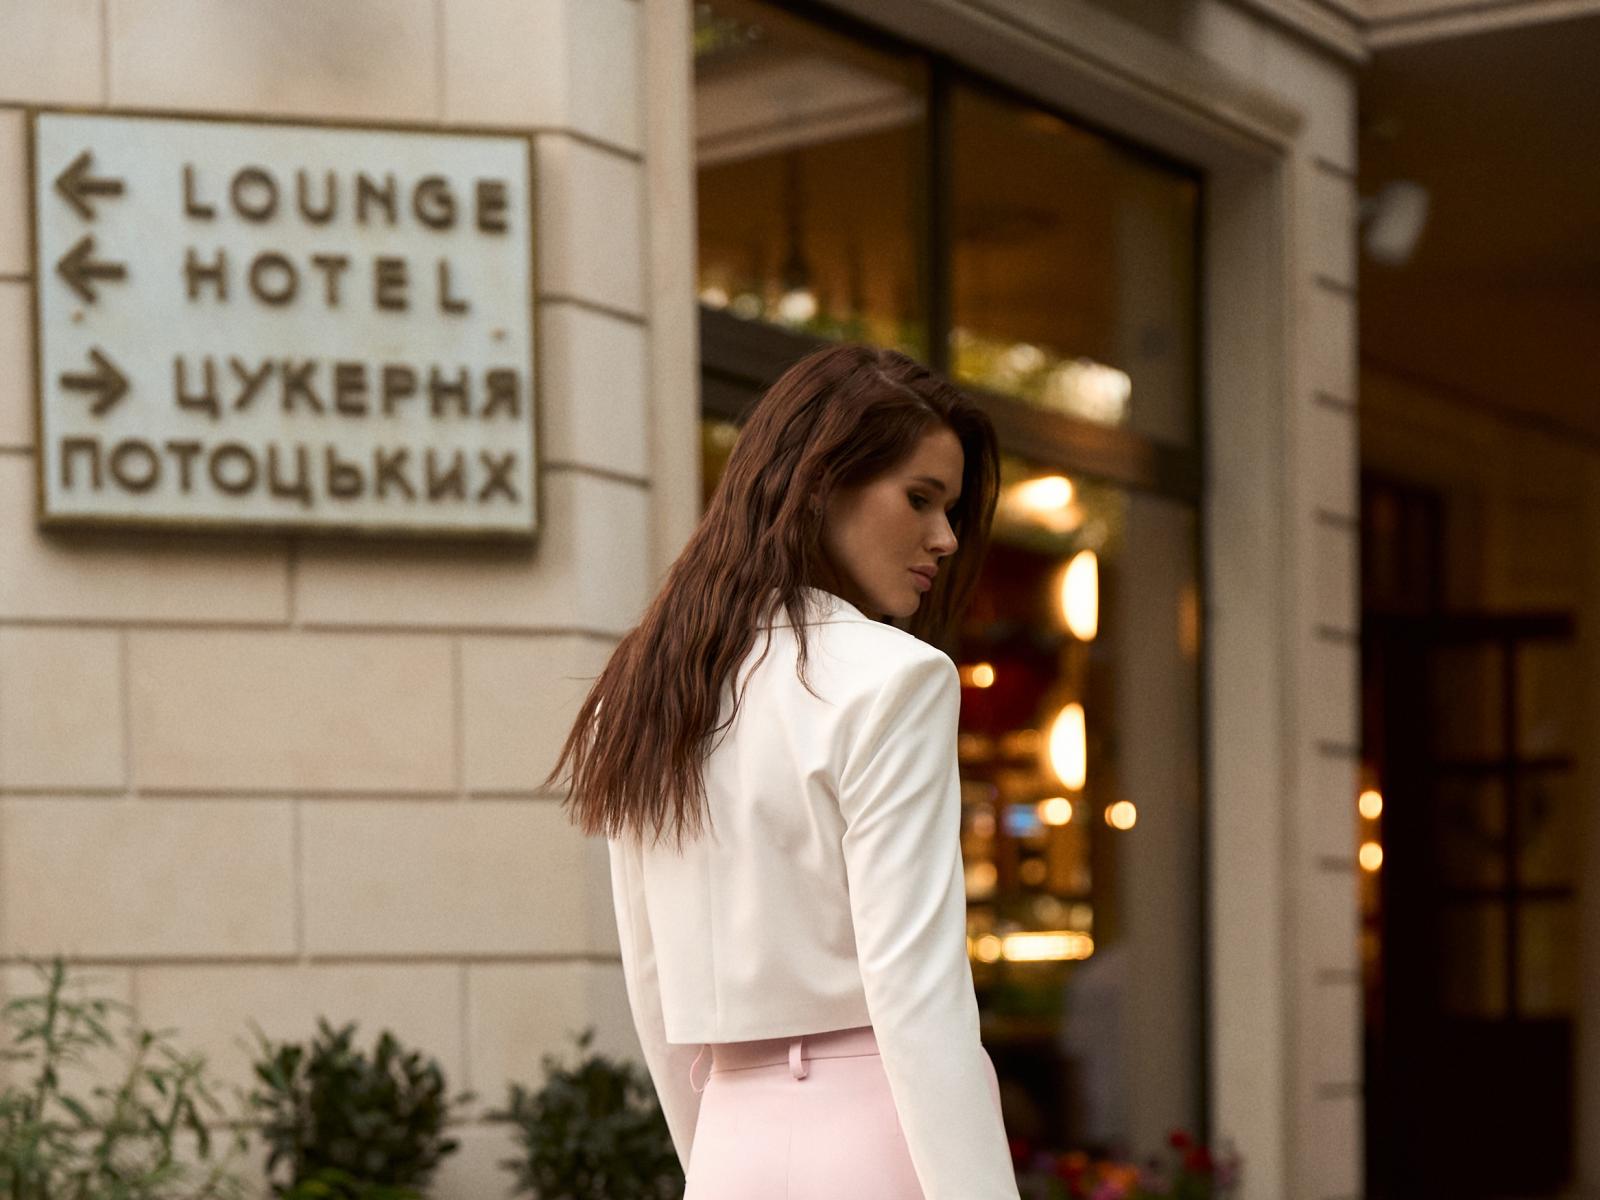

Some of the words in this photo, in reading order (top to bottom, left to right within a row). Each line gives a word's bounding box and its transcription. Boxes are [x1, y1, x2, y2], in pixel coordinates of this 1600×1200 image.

[182, 163, 508, 234] LOUNGE
[184, 247, 470, 314] HOTEL
[174, 354, 521, 420] ЦУКЕРНЯ
[60, 437, 518, 506] ПОТОЦЬКИХ
